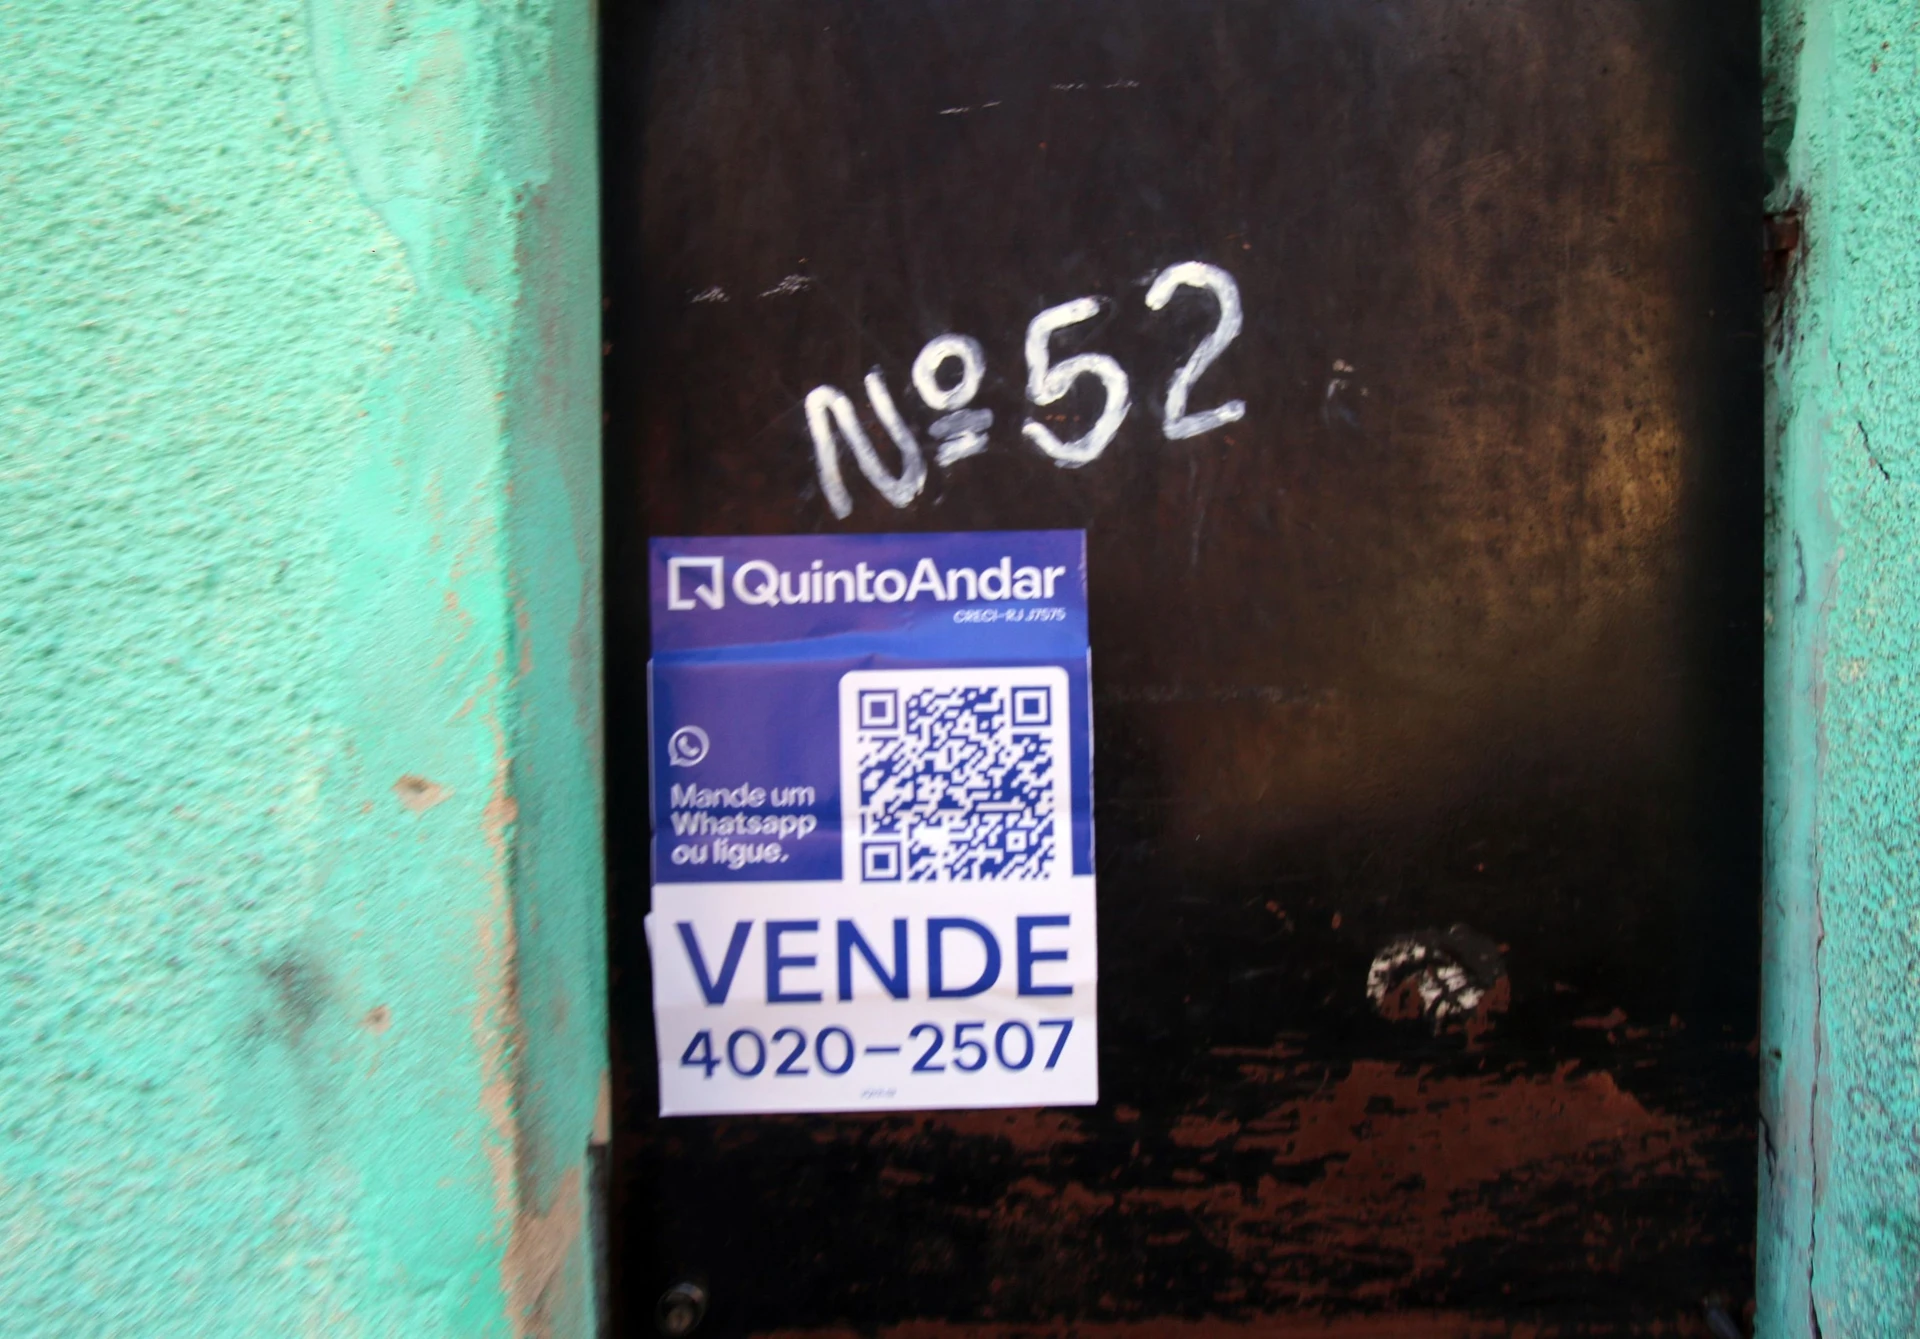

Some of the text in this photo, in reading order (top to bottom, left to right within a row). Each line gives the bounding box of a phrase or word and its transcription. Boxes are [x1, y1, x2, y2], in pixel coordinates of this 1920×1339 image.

[1022, 260, 1246, 468] 52
[732, 556, 1066, 607] QuintoAndar
[670, 782, 815, 809] Mande um
[670, 811, 817, 840] Whatsapp
[671, 837, 789, 870] ou ligue.
[675, 914, 1074, 1006] VENDE
[680, 1018, 1075, 1080] 4020-2507
